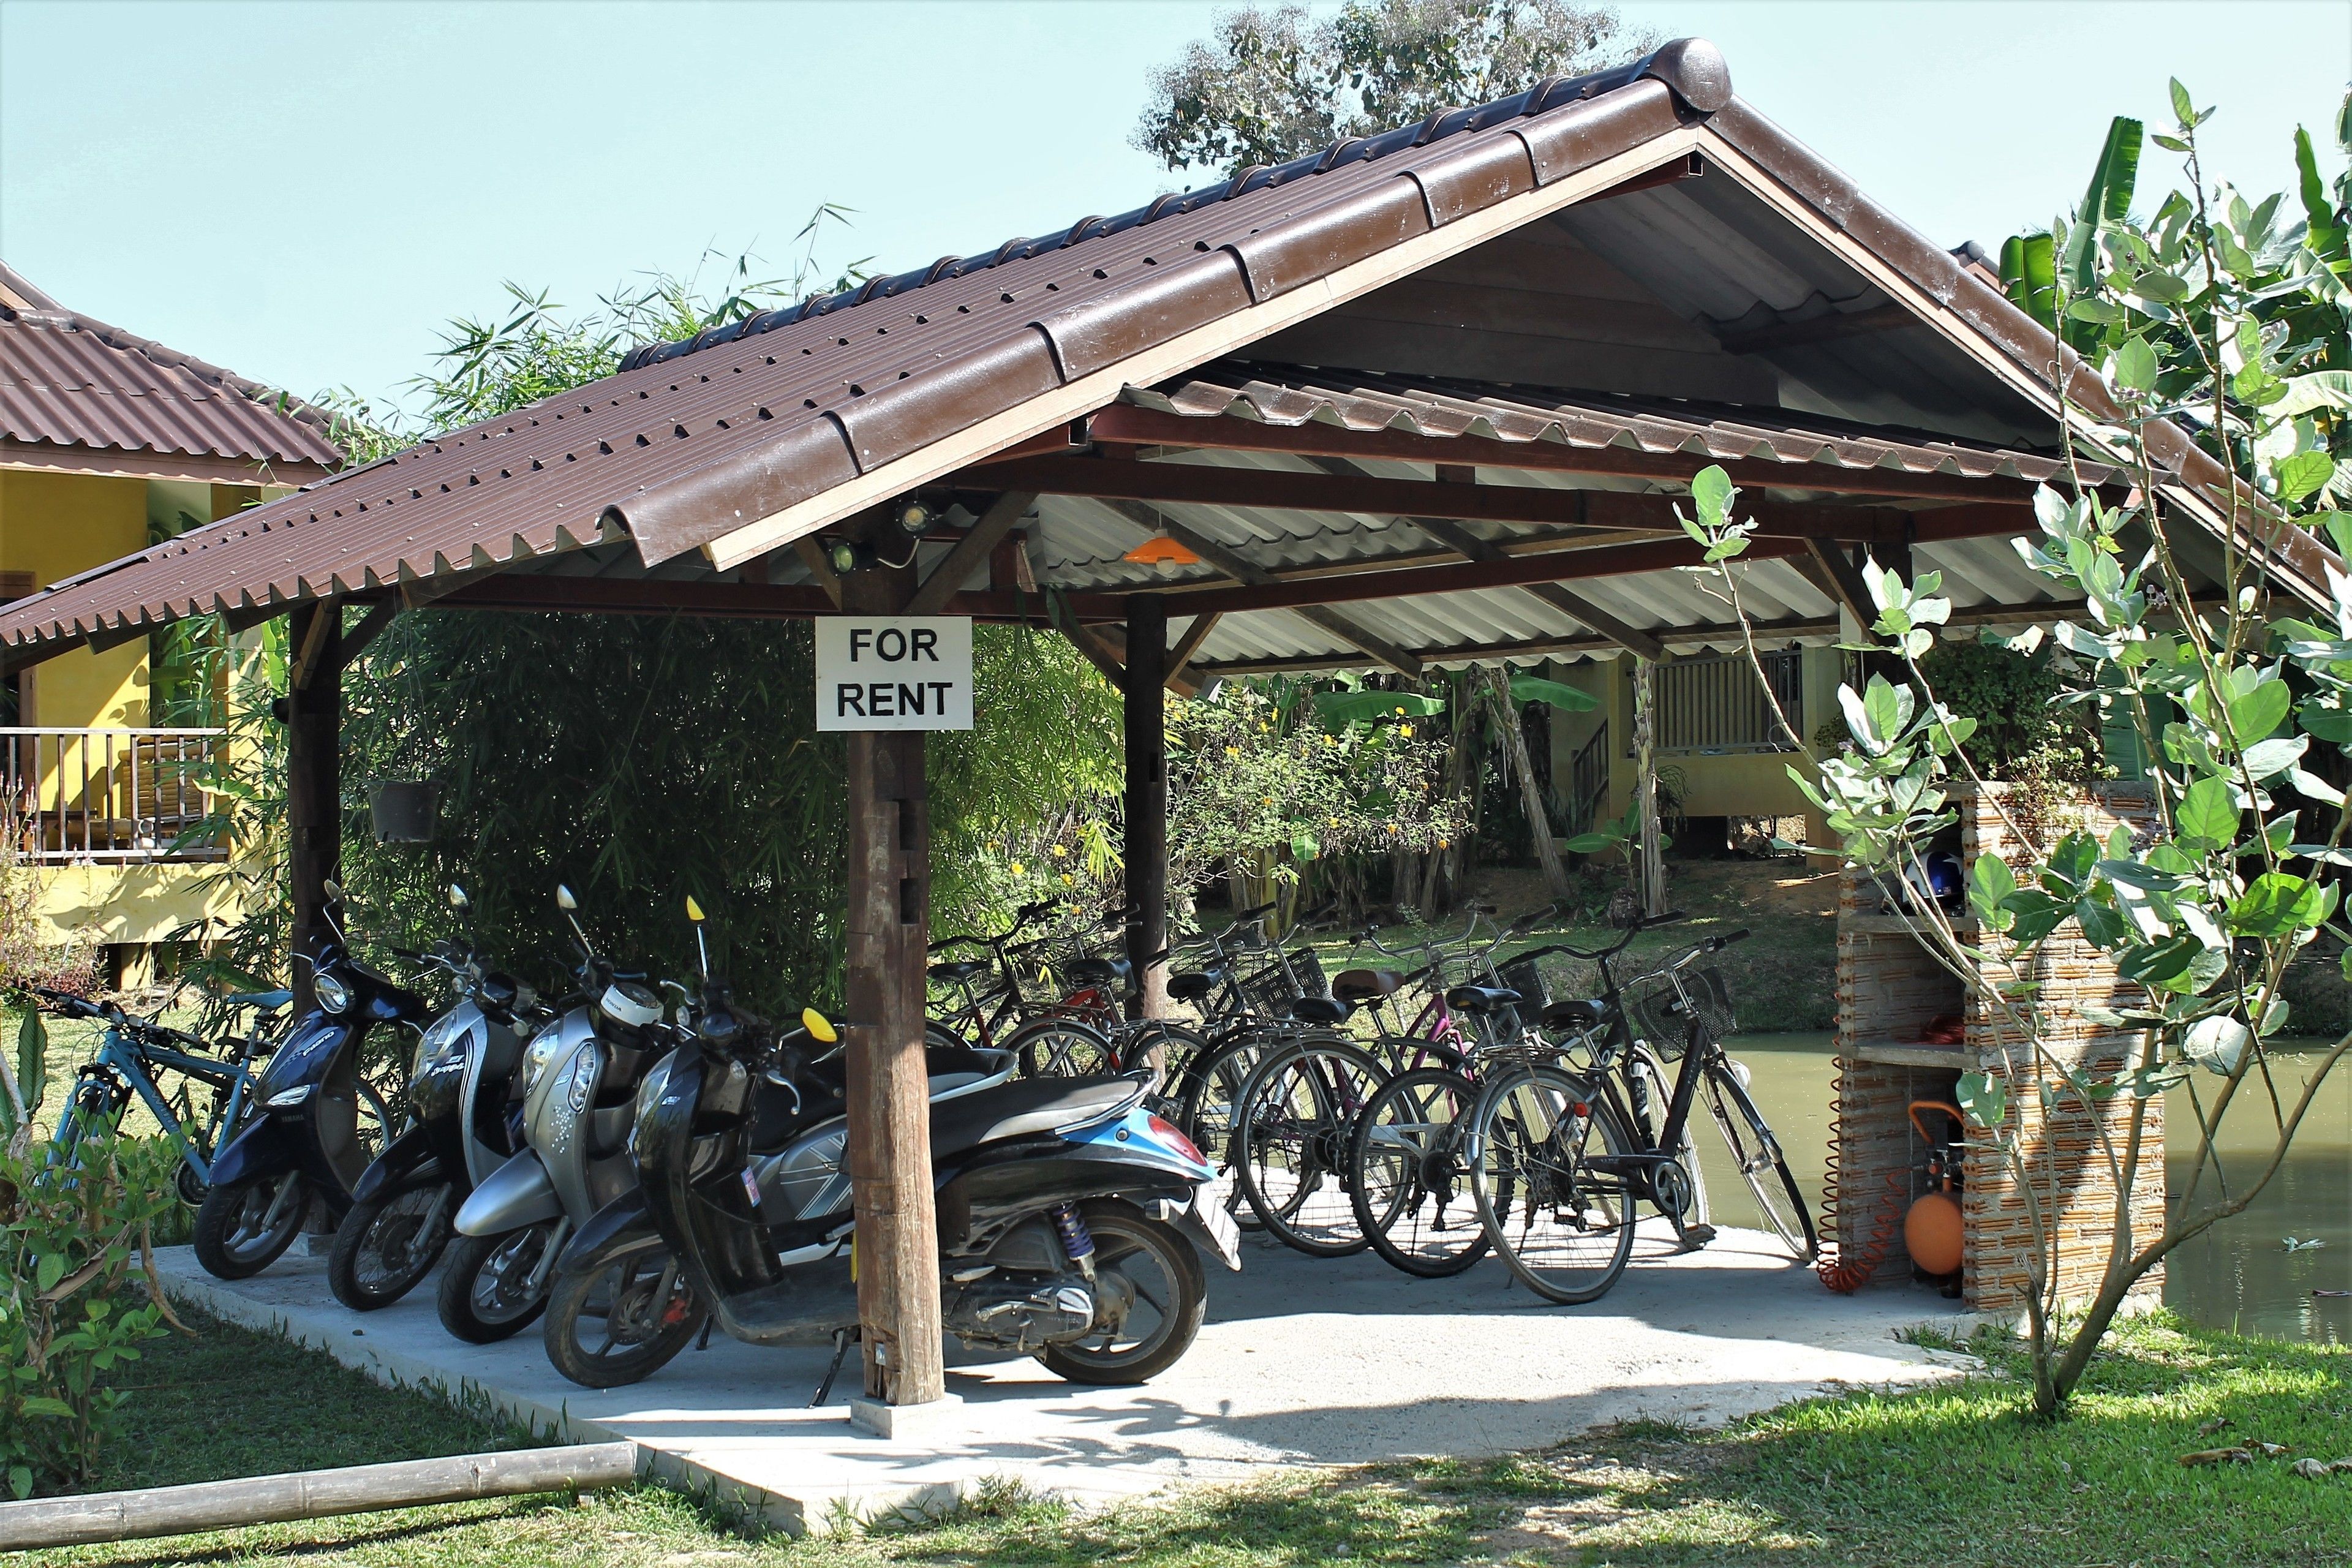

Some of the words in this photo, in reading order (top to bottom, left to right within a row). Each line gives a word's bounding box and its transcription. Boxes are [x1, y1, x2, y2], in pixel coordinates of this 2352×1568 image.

[850, 628, 939, 662] FOR
[837, 682, 953, 717] RENT
[482, 990, 497, 1004] HONDA
[606, 998, 622, 1011] HONDA
